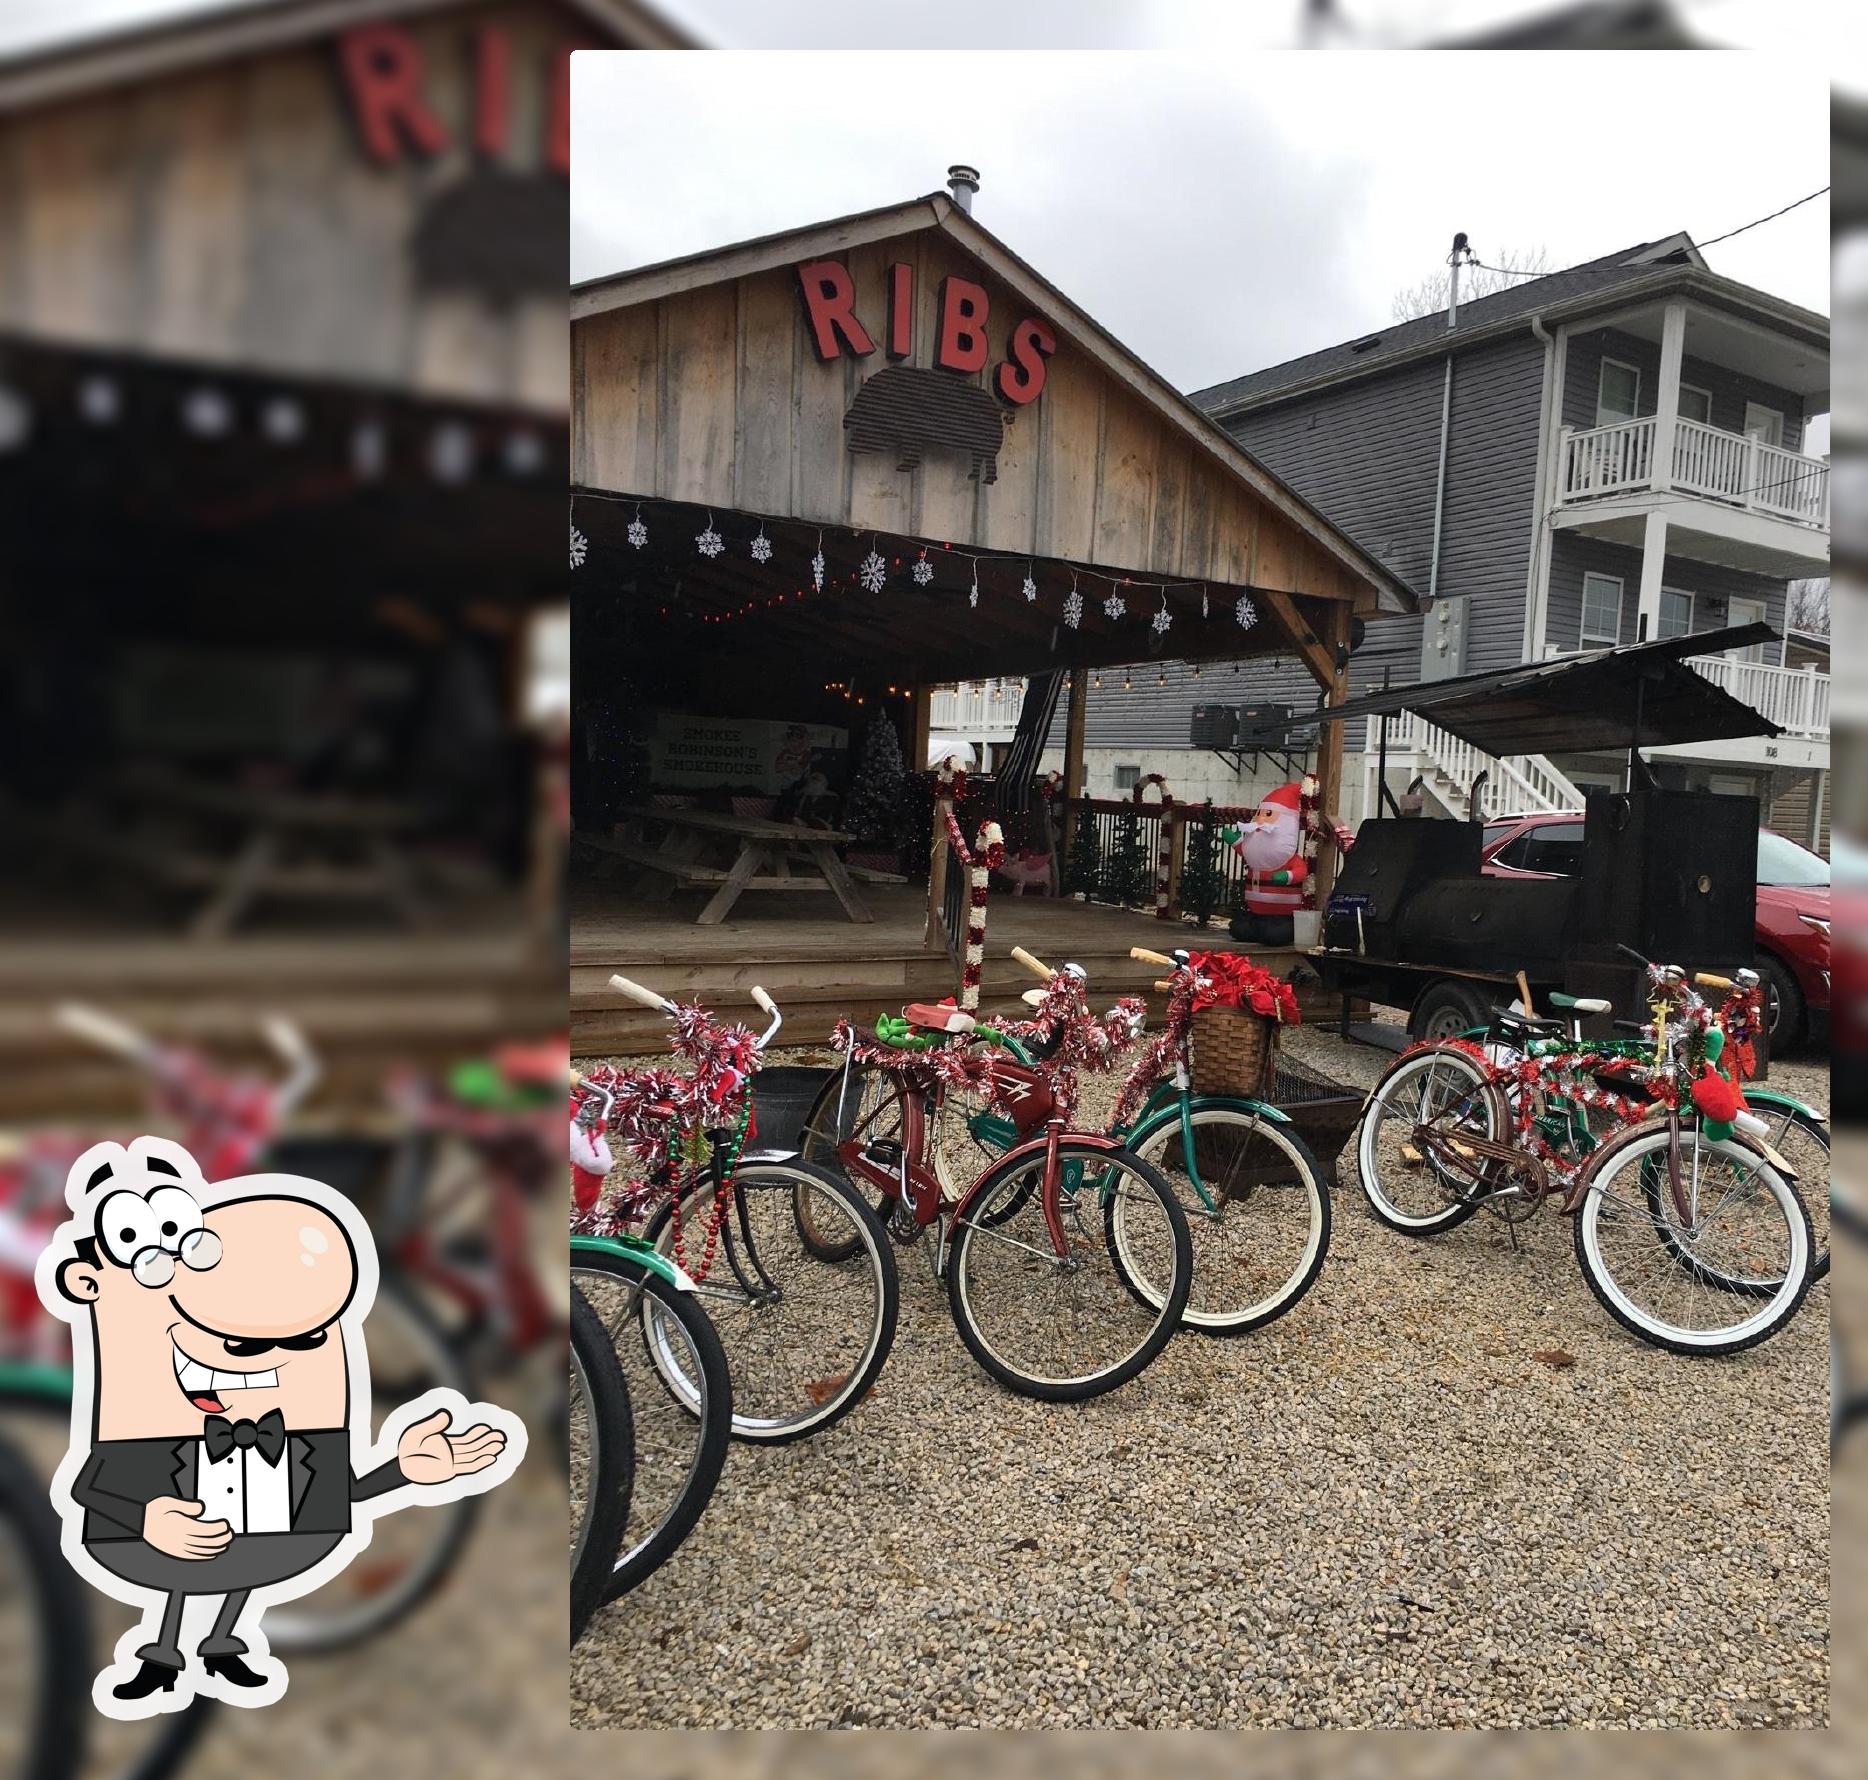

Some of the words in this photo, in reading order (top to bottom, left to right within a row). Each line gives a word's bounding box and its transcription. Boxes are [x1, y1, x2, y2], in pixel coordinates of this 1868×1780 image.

[337, 22, 569, 178] RI
[797, 260, 1056, 404] RIBS
[663, 759, 764, 776] SMOKEHOUSE
